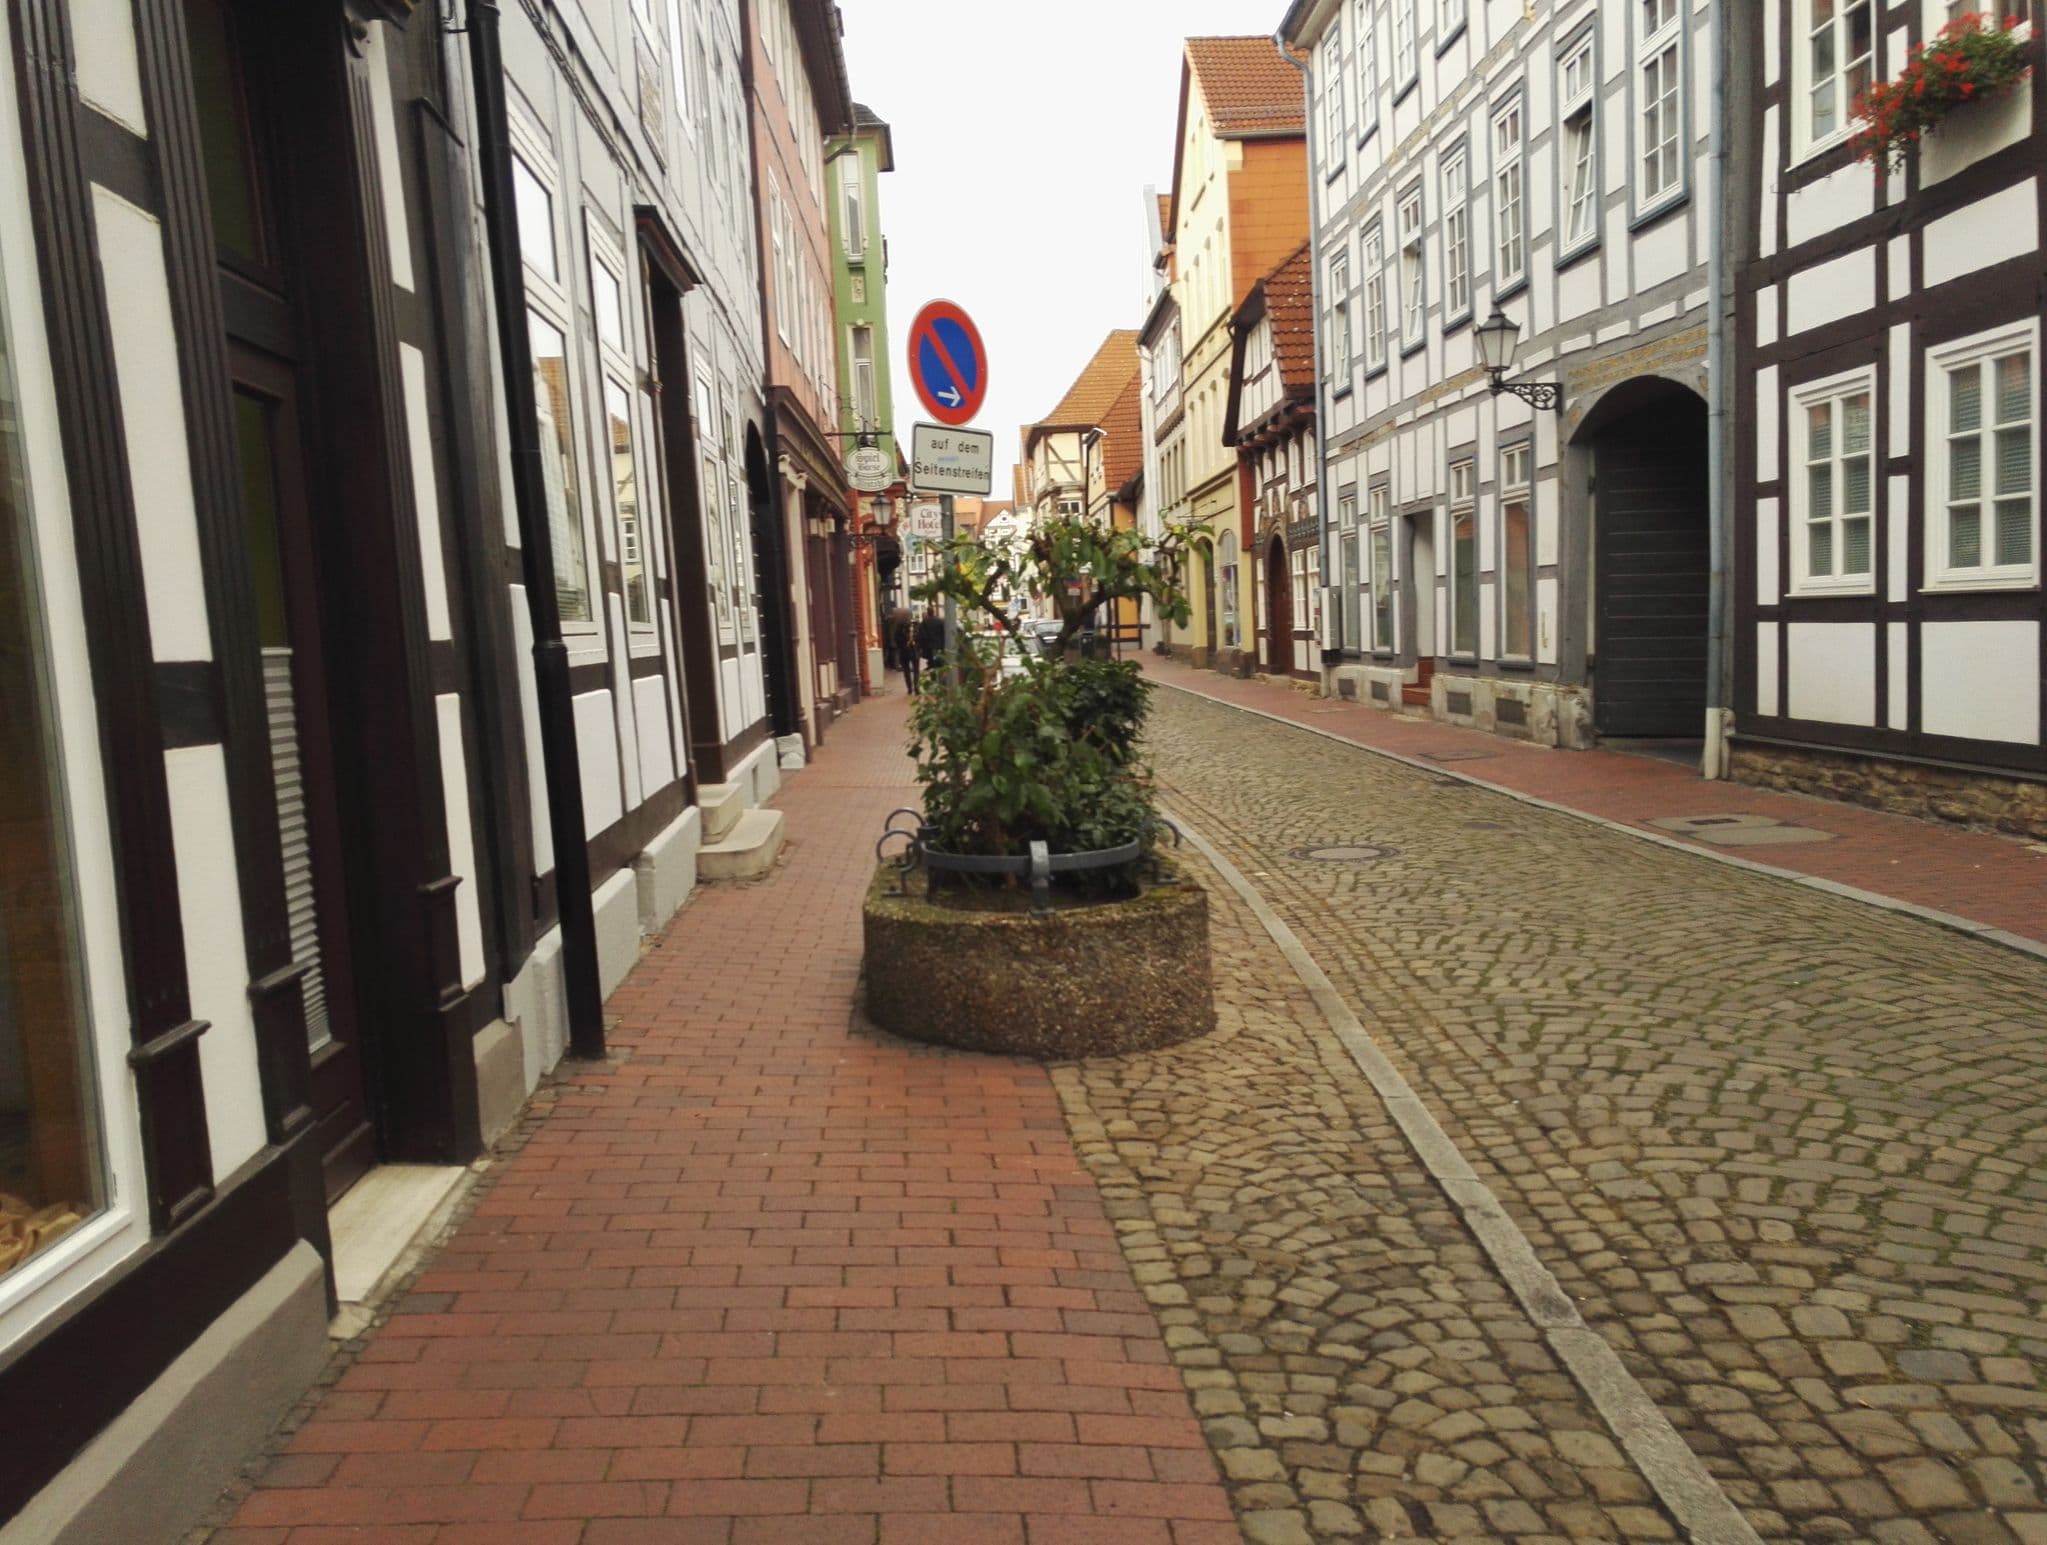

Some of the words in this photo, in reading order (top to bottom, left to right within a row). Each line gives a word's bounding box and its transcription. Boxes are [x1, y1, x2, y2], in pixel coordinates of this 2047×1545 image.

[931, 438, 950, 450] auf
[958, 441, 979, 454] dem
[914, 461, 989, 480] Seitenstreifen
